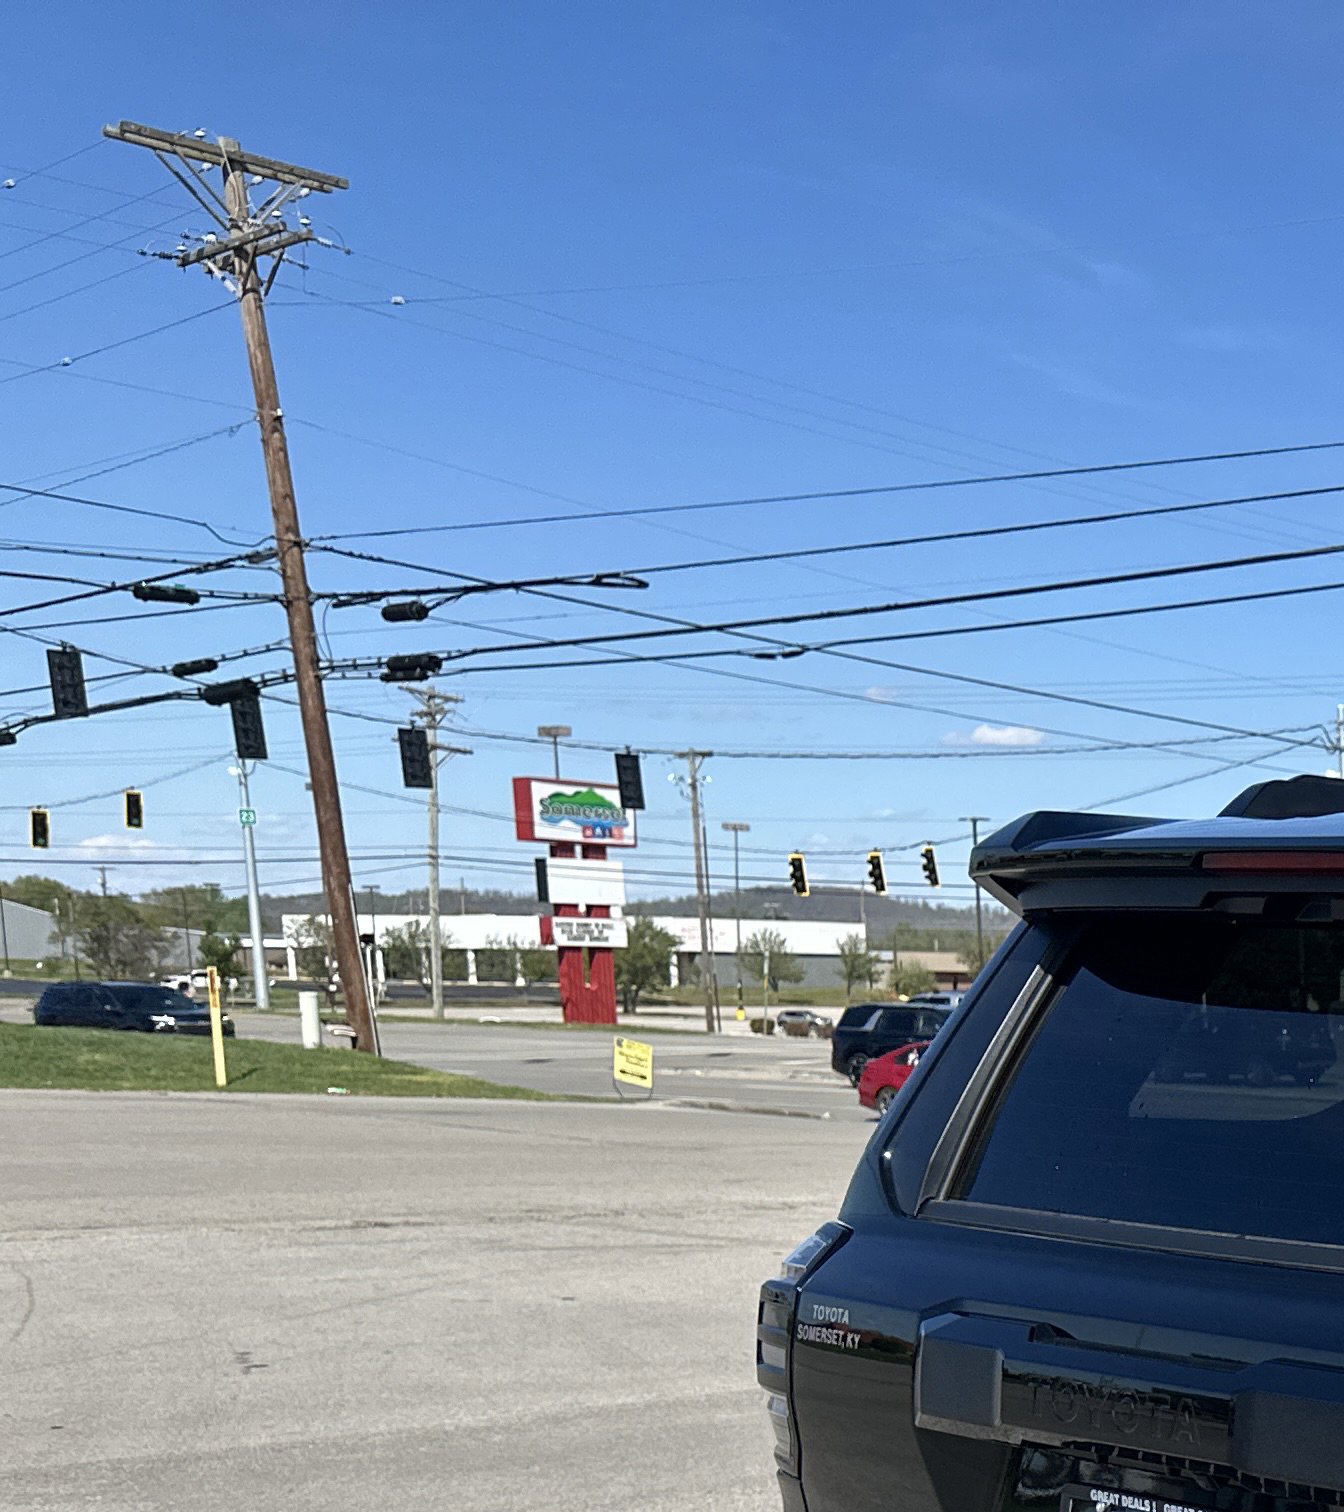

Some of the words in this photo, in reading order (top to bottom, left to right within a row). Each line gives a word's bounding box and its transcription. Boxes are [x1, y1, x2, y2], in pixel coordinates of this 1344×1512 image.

[812, 1304, 850, 1325] TOYOTA
[846, 1332, 861, 1349] KY
[1027, 1380, 1201, 1444] TOYOTA
[1090, 1488, 1120, 1505] GREAT
